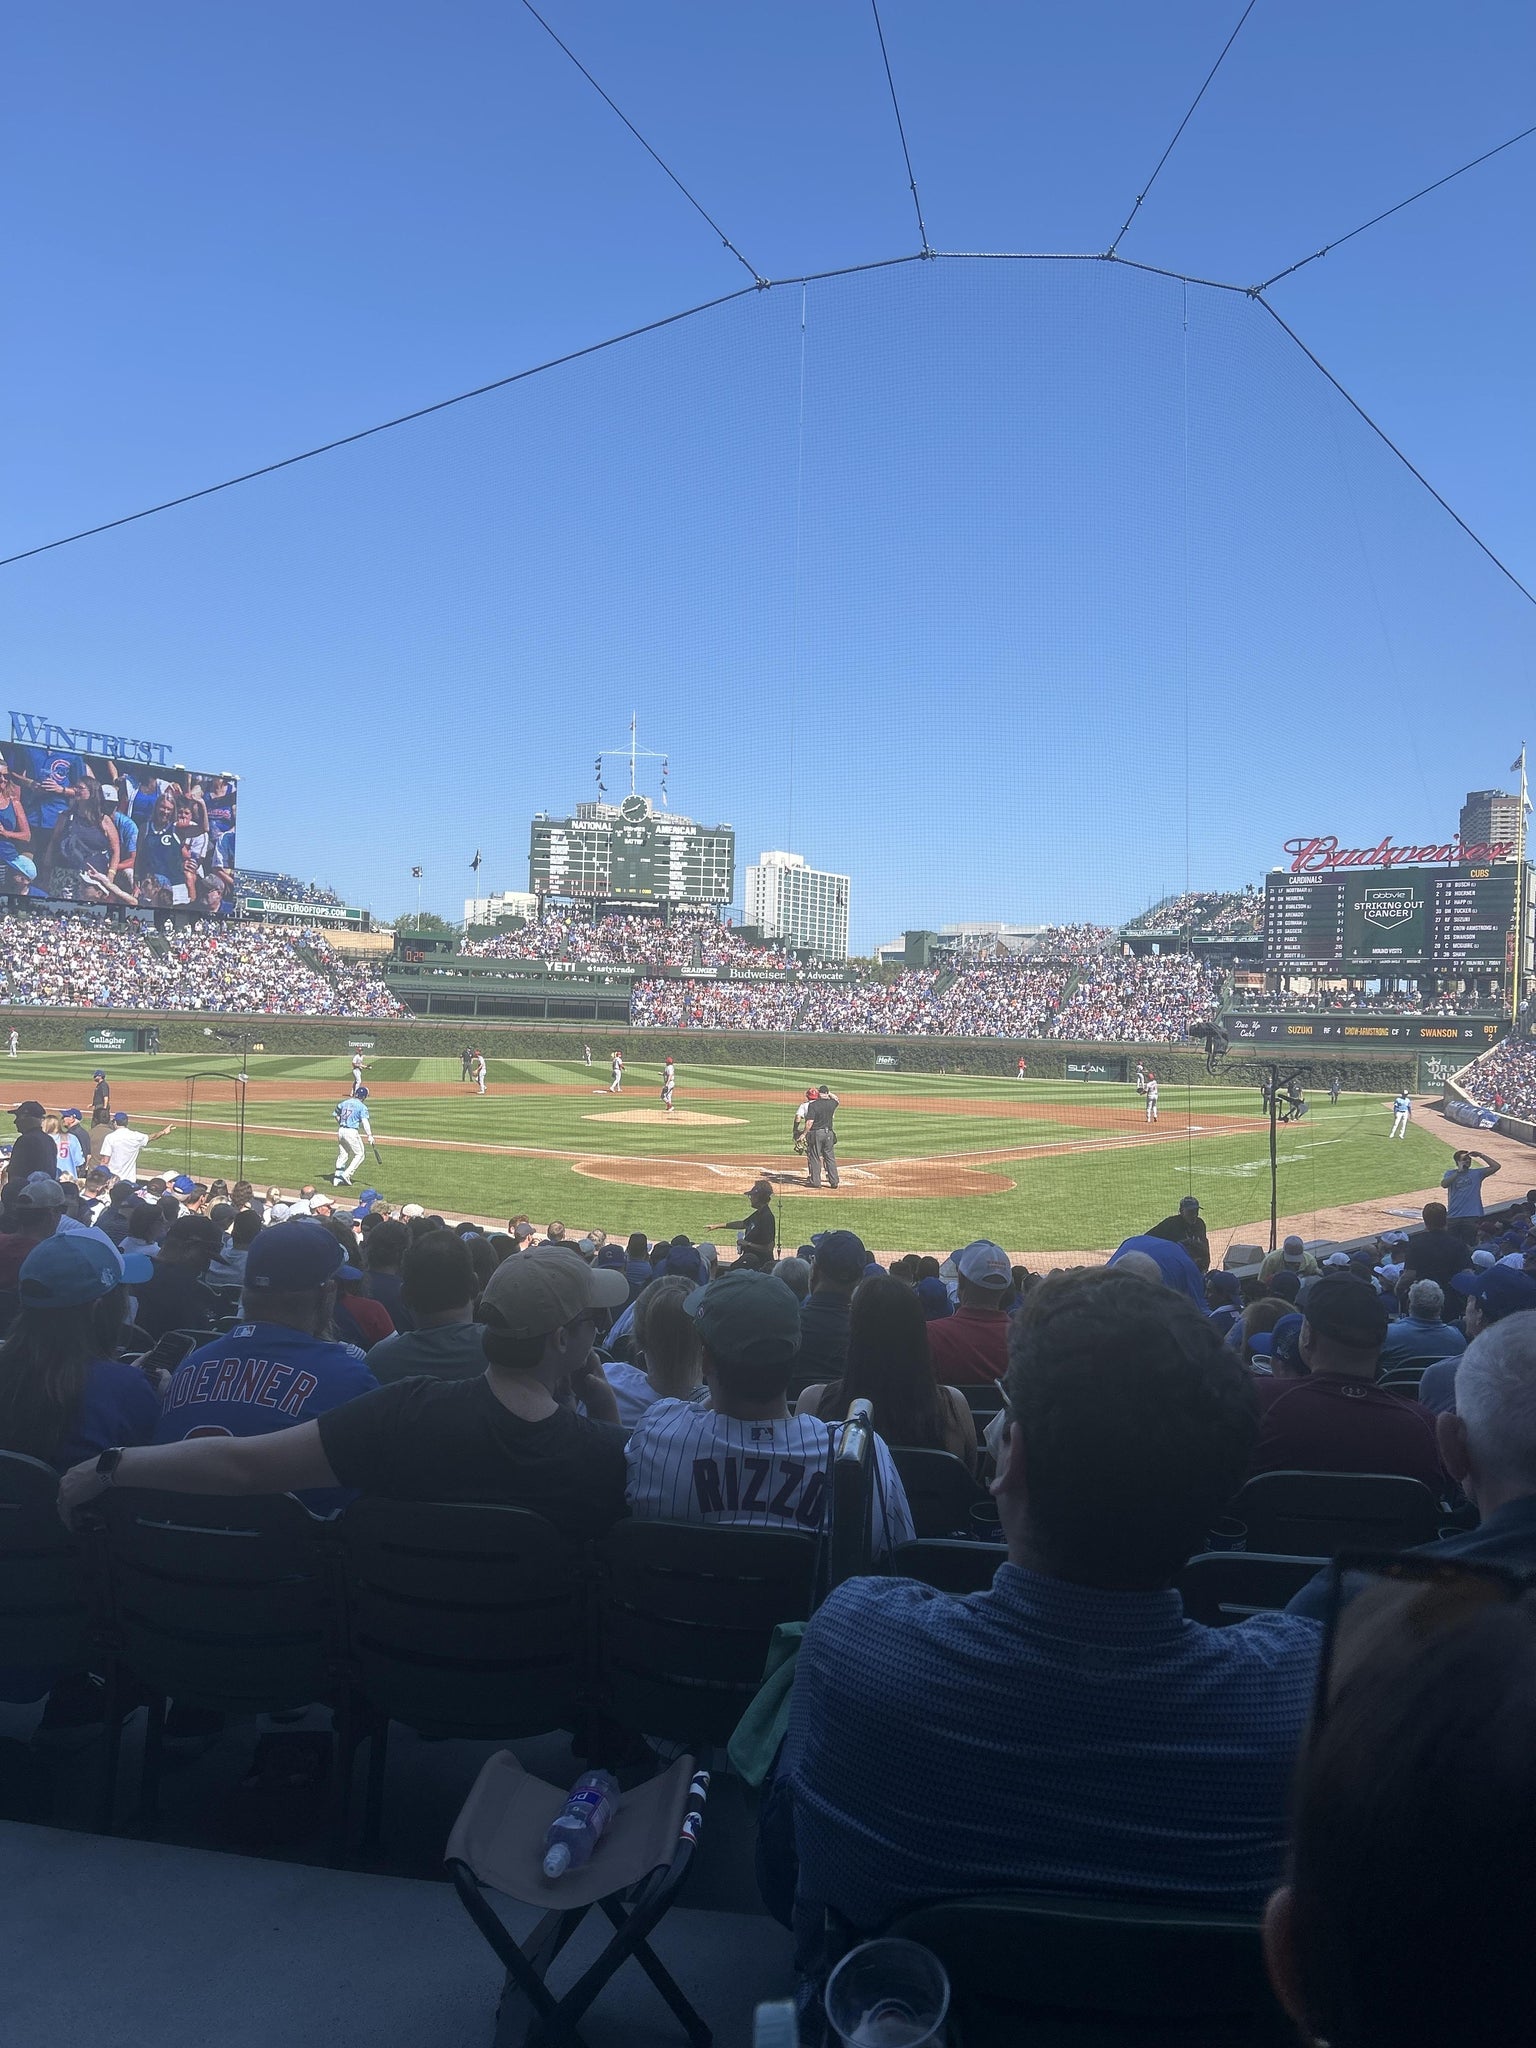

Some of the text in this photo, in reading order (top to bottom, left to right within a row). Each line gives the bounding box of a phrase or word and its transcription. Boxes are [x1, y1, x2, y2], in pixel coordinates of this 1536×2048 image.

[8, 711, 172, 766] WINTRUST
[572, 821, 613, 830] NATIONAL
[656, 826, 696, 835] AMERICAN
[1284, 833, 1514, 872] Budweiser
[1470, 870, 1489, 878] CUBS
[1289, 876, 1322, 884] CARDINALS
[263, 900, 346, 917] WRIGLEYROOFTOPS.COM
[1354, 902, 1401, 910] STRIKING
[545, 962, 576, 972] YETI
[592, 965, 635, 974] tastytrade
[807, 972, 843, 980] Advocate
[1252, 1021, 1260, 1029] Up
[1288, 1026, 1312, 1034] SUZUKI
[1344, 1027, 1389, 1036] CROW-ARMSTRONG
[1420, 1029, 1458, 1038] SWANSON
[1484, 1026, 1498, 1034] BOT
[90, 1036, 126, 1044] Gallagher
[692, 1456, 826, 1527] RIZZO
